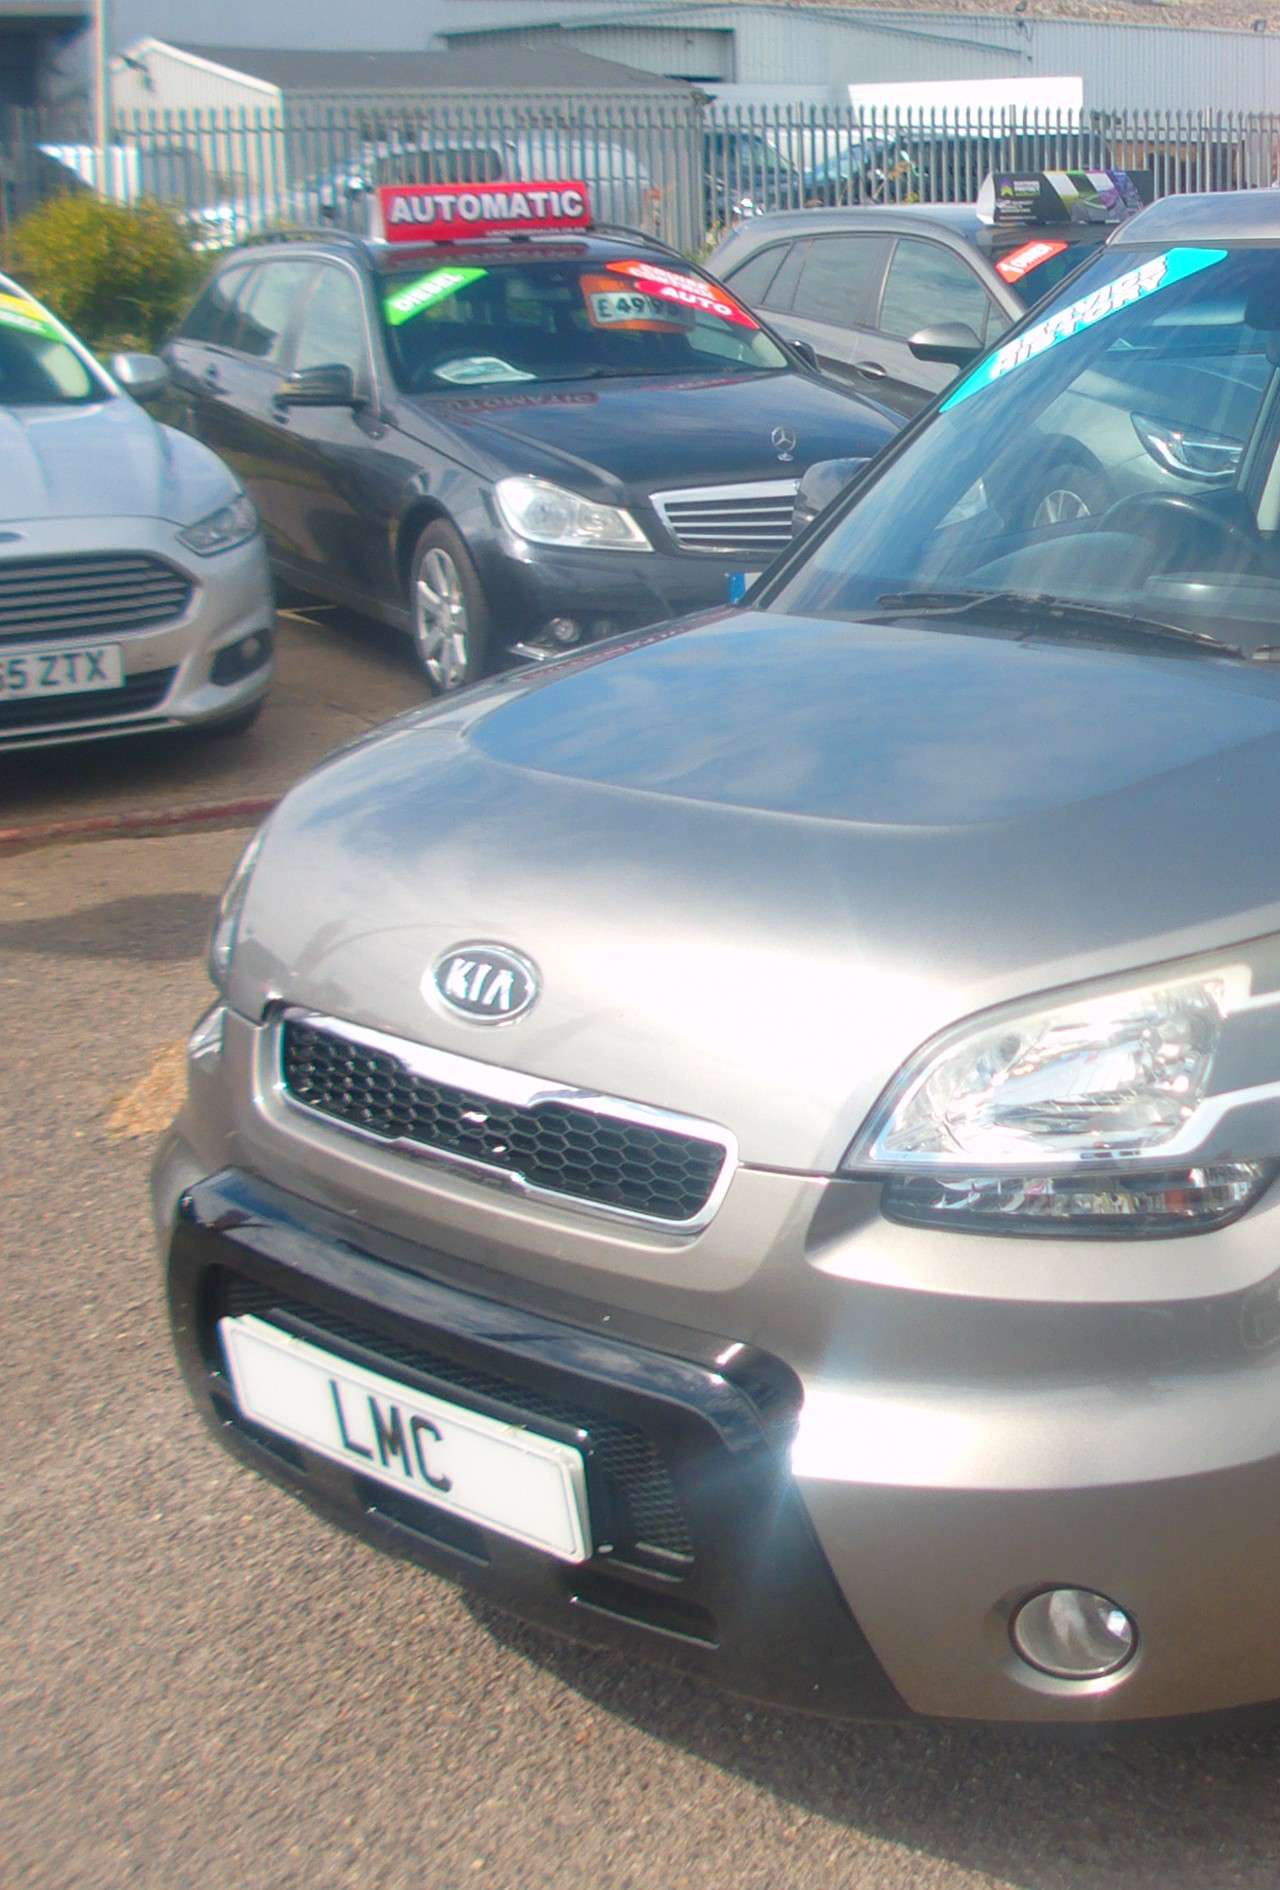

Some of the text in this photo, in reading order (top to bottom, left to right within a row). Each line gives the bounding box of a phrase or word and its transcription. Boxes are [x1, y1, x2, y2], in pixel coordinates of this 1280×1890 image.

[389, 189, 584, 223] AUTOMATIC
[660, 287, 732, 316] AUTO
[37, 650, 106, 686] ZTX
[446, 958, 514, 1011] KIA
[329, 1380, 452, 1493] LMC
